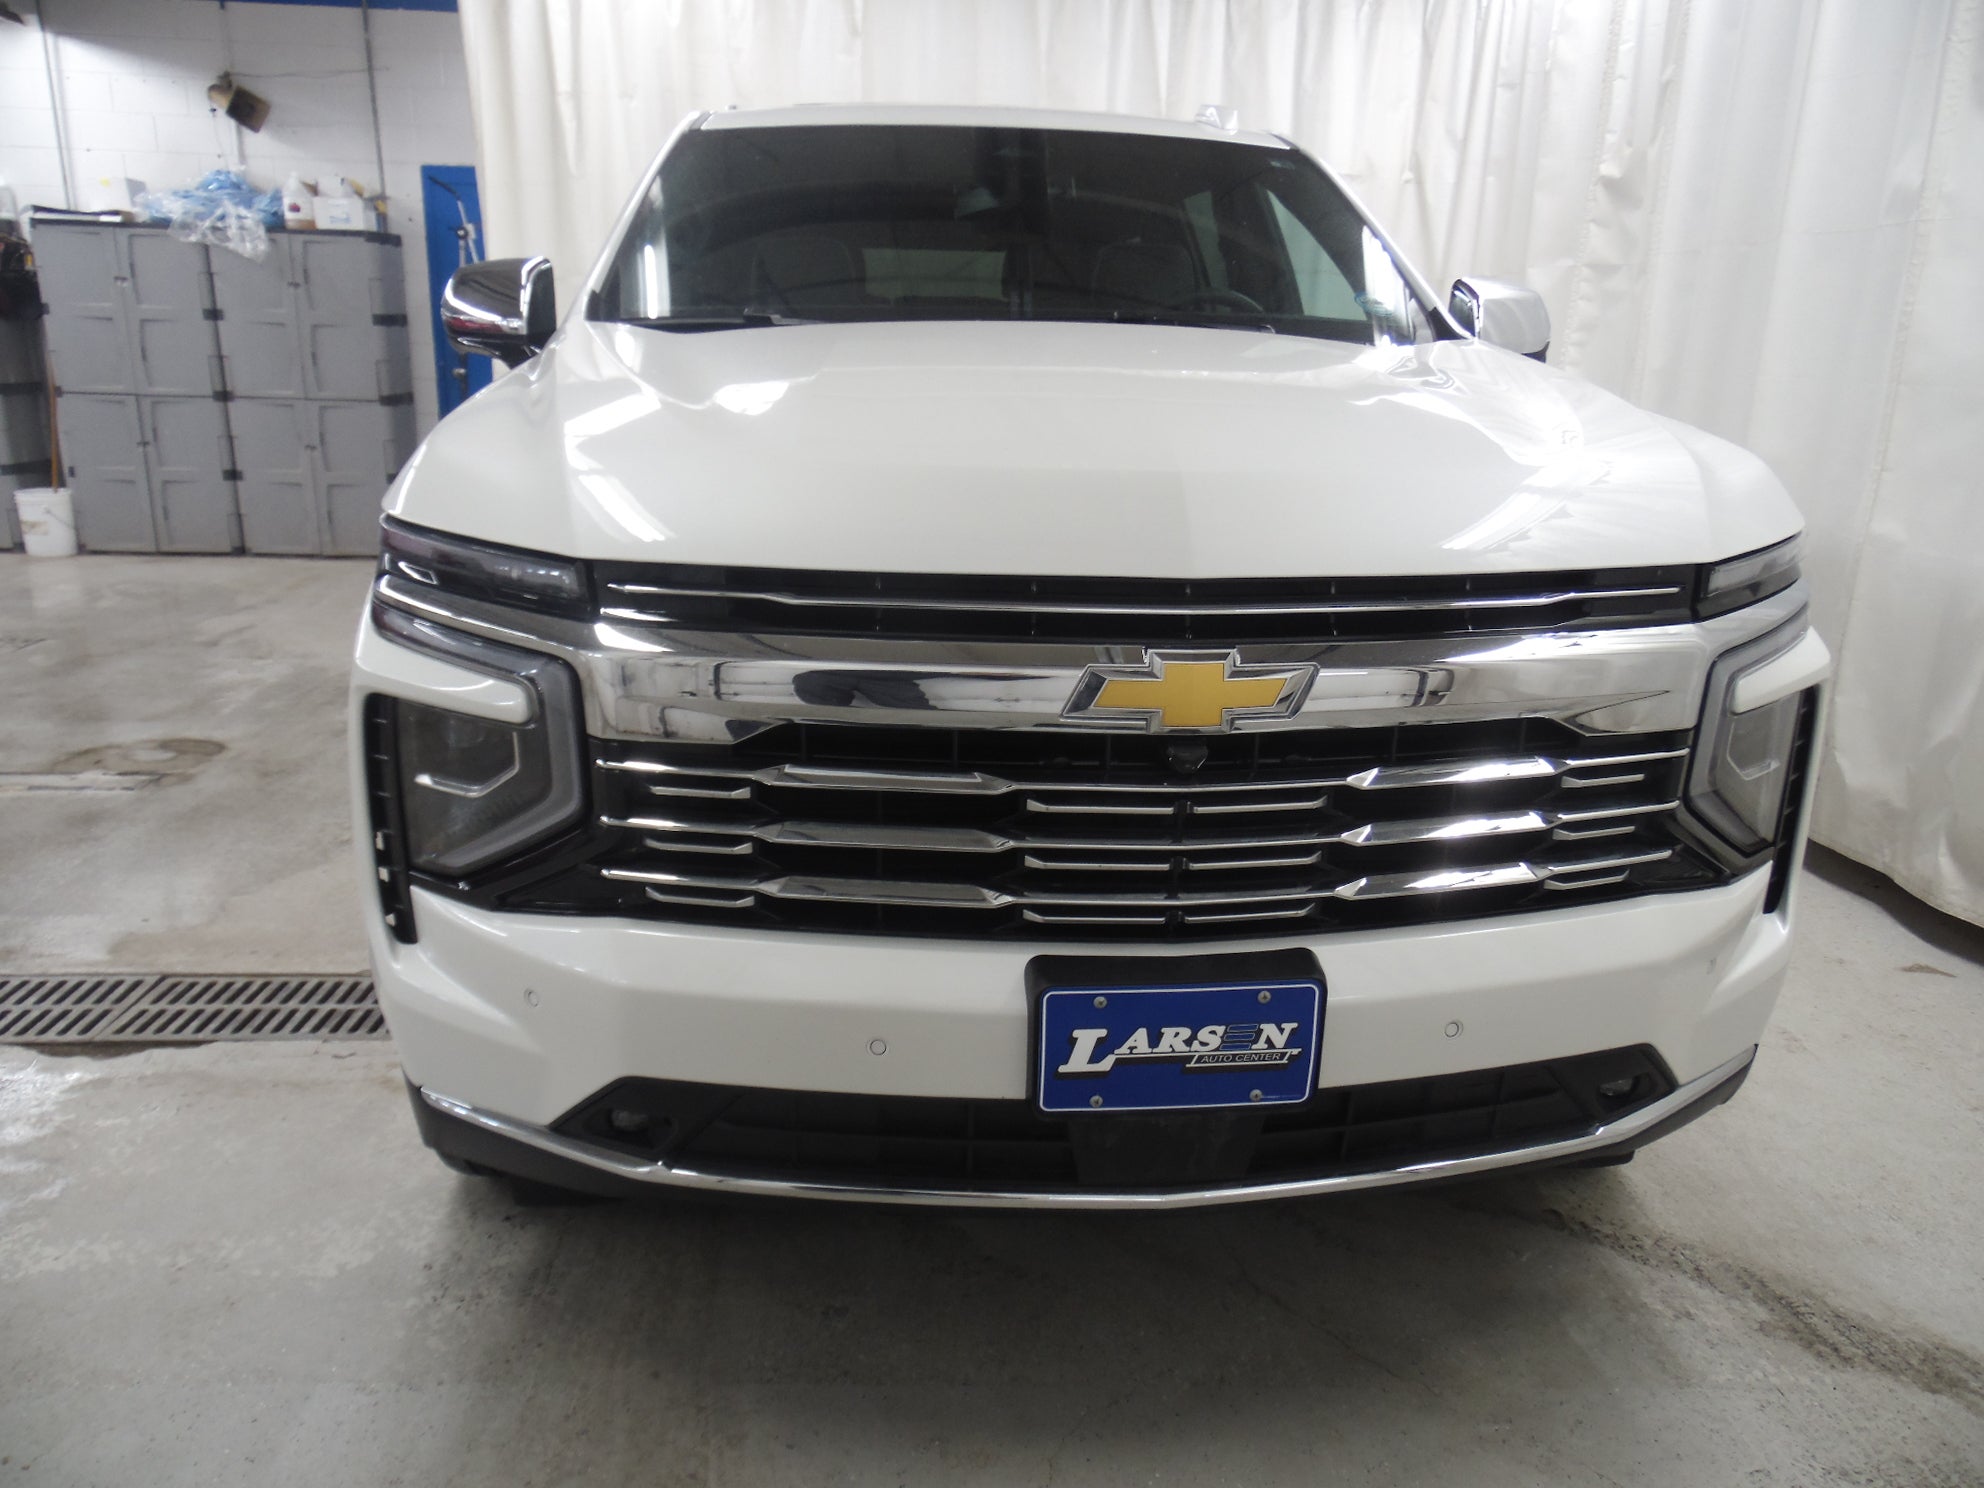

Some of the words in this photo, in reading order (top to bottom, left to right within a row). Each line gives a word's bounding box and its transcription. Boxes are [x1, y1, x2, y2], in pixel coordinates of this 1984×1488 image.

[1057, 1022, 1299, 1073] LARSEN
[1200, 1054, 1233, 1063] AUTO
[1235, 1052, 1281, 1062] CENTER
